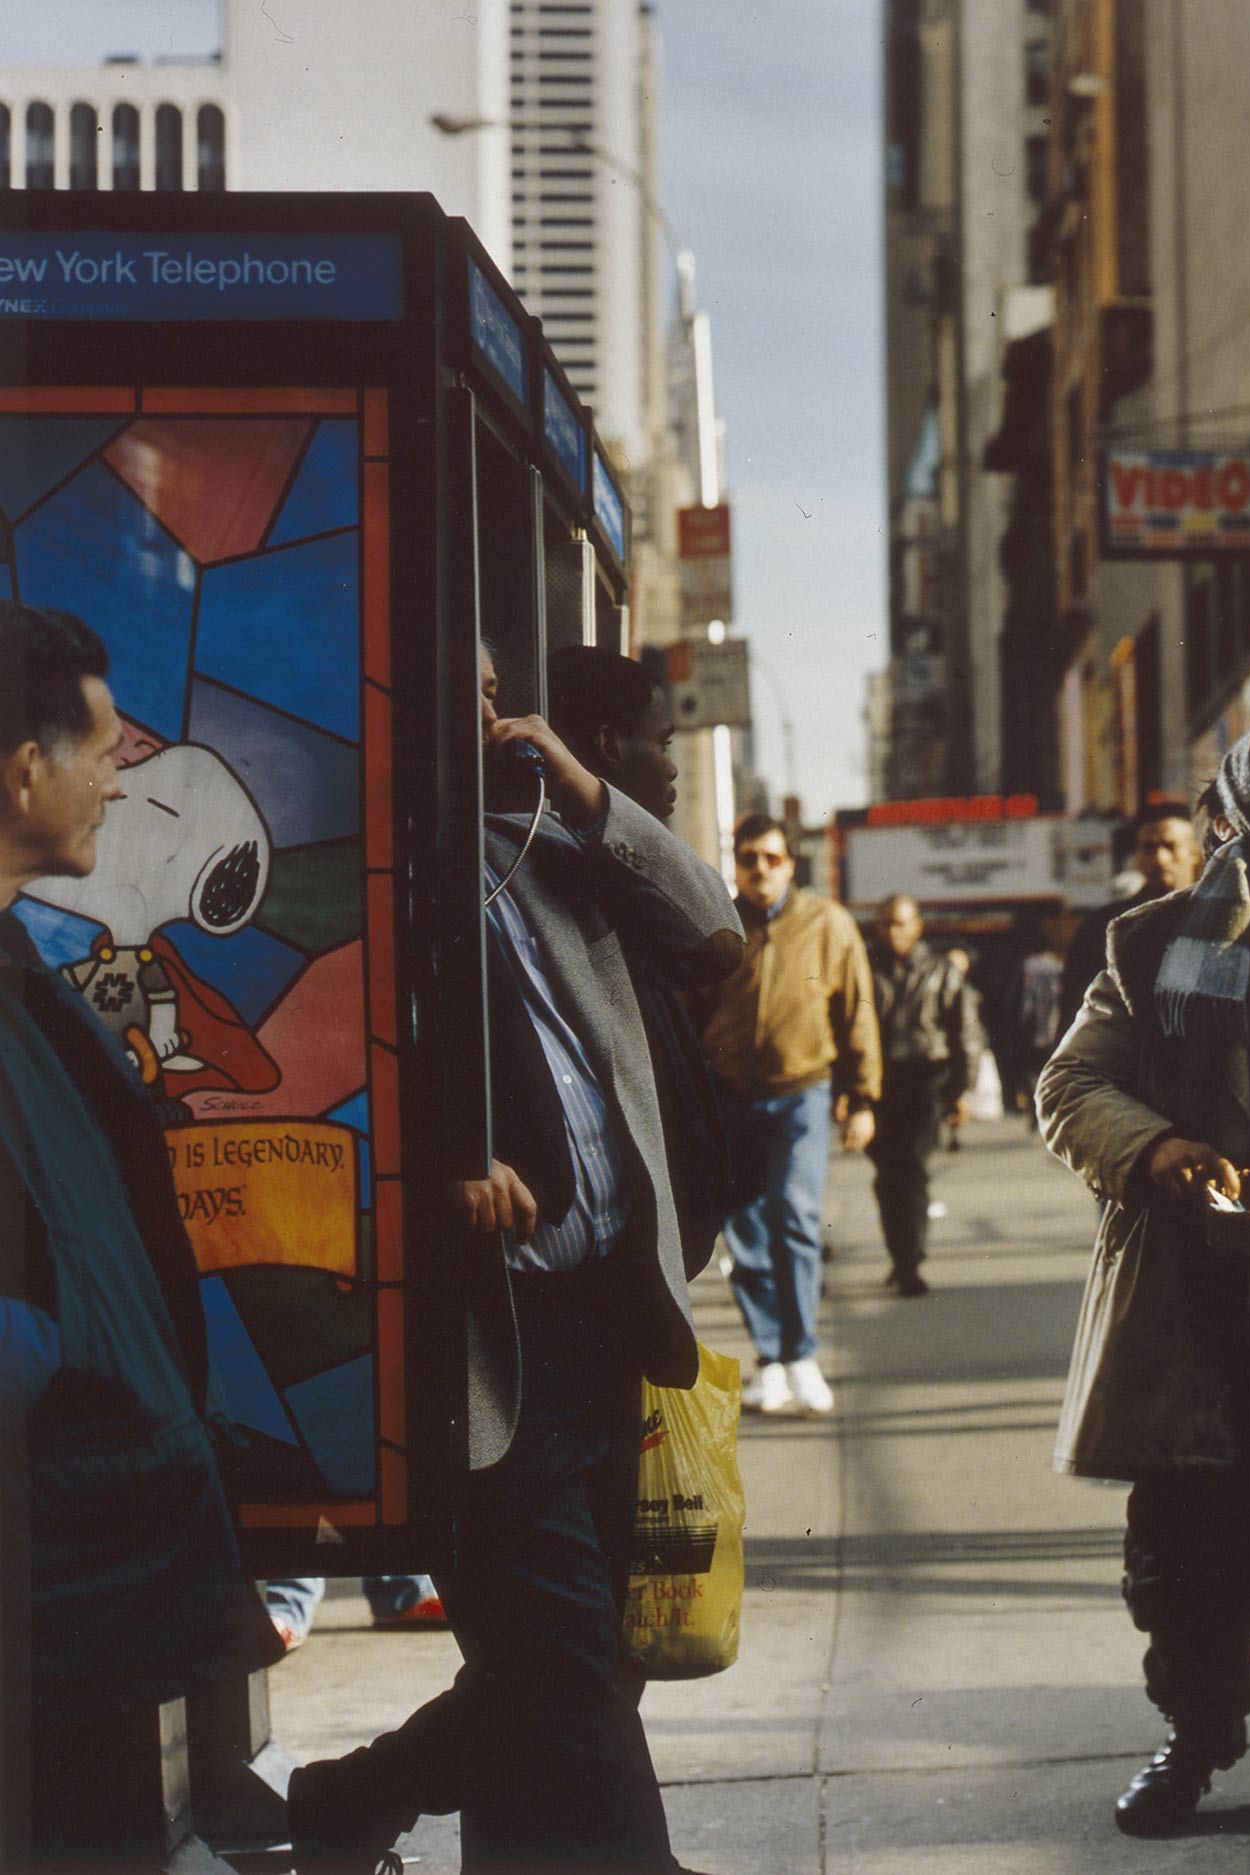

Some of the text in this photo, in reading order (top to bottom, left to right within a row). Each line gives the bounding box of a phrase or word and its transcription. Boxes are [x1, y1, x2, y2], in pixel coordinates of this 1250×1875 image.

[0, 250, 337, 290] ew York Telephone
[186, 1142, 205, 1169] IS
[212, 1134, 345, 1173] LEGENDARY.
[672, 1493, 703, 1511] Bell
[653, 1577, 703, 1600] Book
